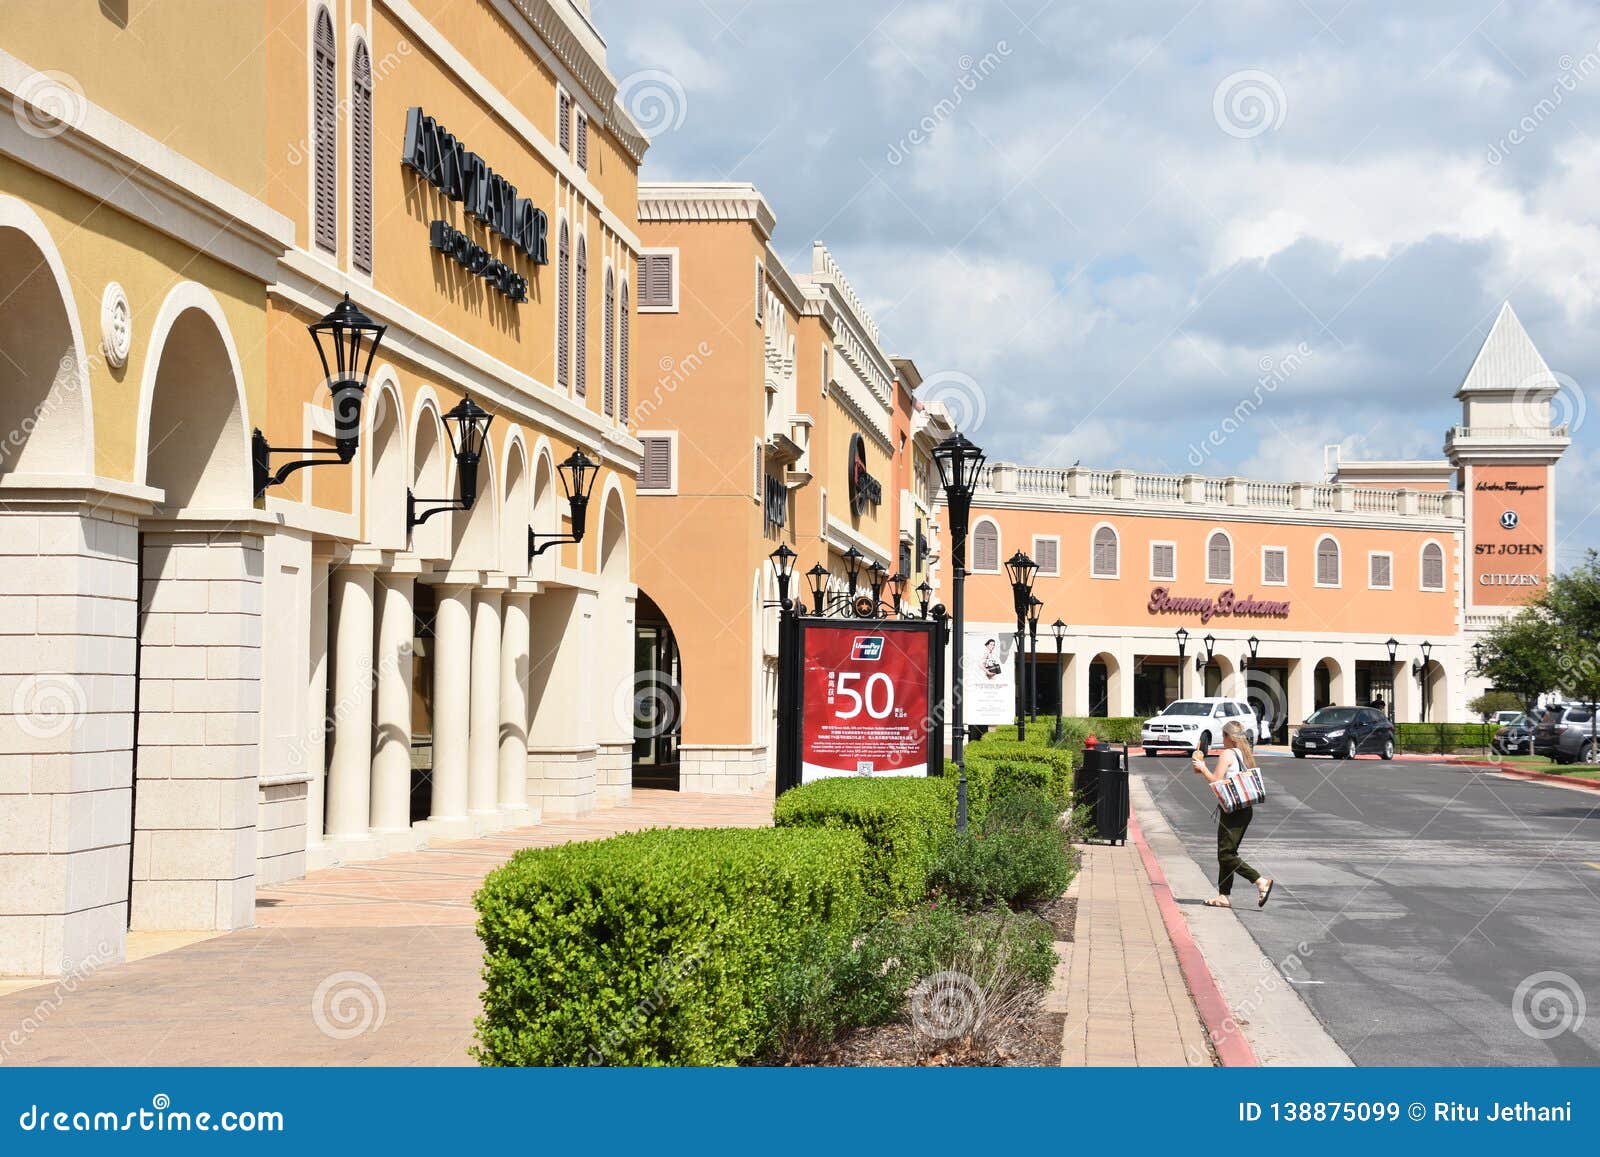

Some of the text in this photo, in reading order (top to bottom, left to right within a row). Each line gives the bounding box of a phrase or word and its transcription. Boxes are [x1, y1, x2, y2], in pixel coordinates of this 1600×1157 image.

[1498, 544, 1544, 555] JOHN
[1480, 574, 1539, 587] CITIZEN
[1148, 587, 1290, 625] Tommy Bahama
[834, 672, 895, 720] 50
